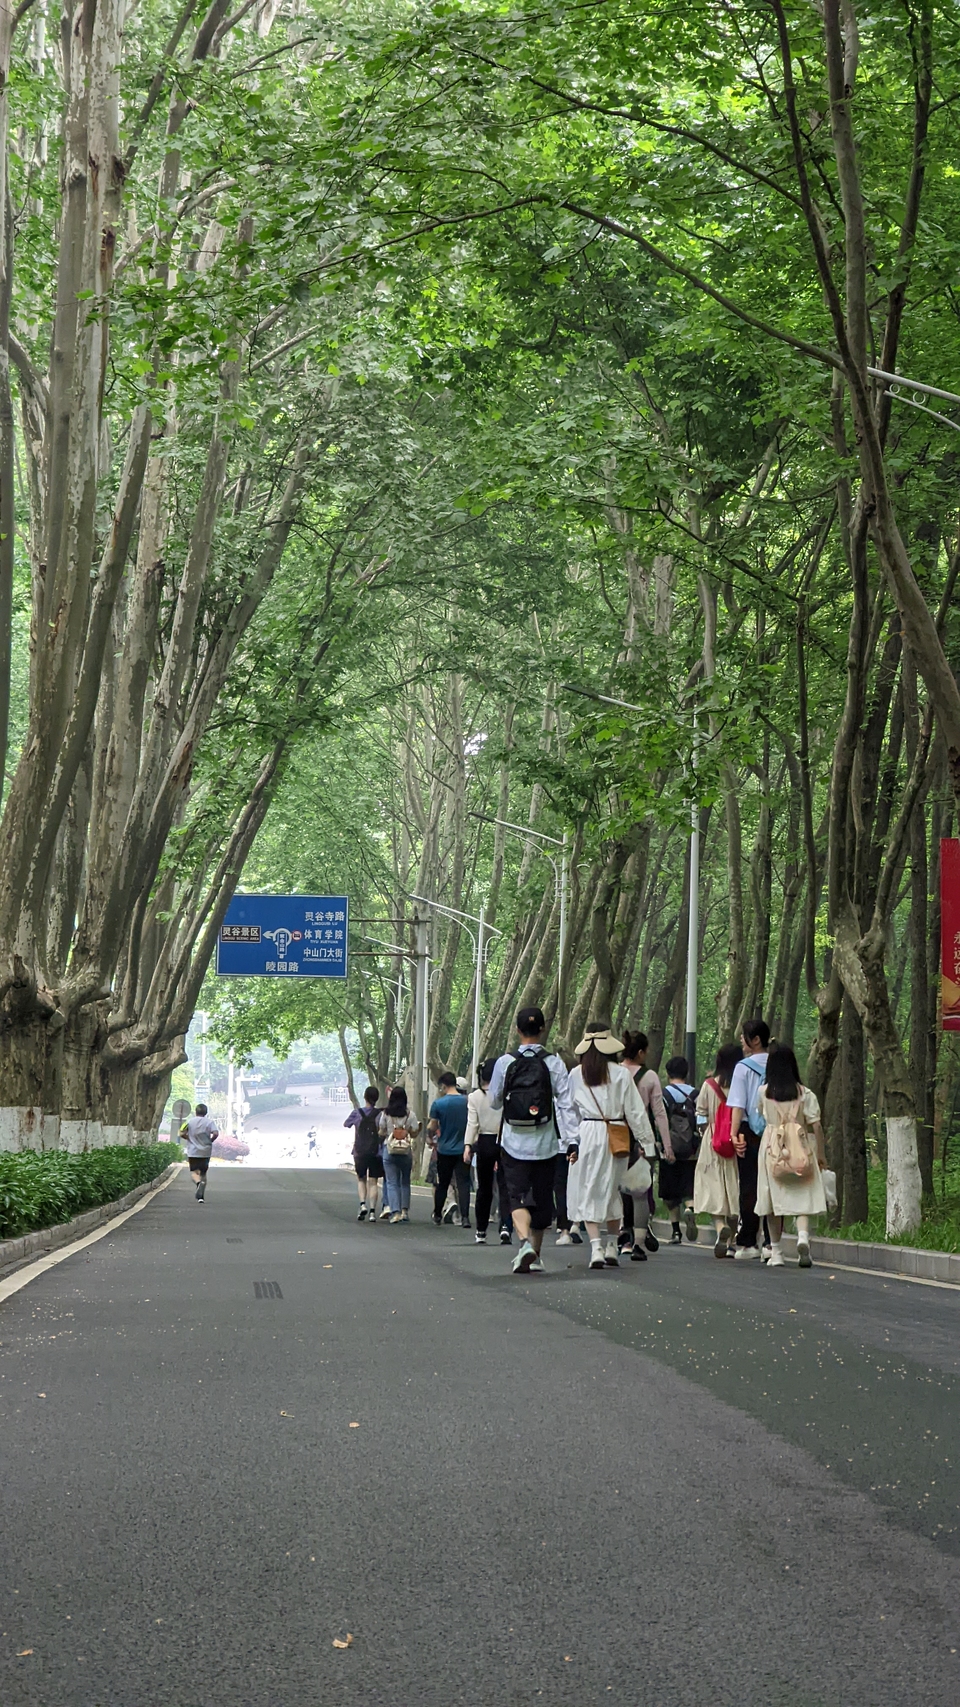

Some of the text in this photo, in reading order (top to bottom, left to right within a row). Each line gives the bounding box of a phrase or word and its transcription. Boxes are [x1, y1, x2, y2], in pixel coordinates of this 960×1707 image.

[305, 911, 344, 921] 灵谷寺路
[222, 927, 259, 936] 灵谷景区
[304, 929, 343, 940] 体育学院
[304, 948, 343, 957] 中山门大街
[265, 961, 299, 972] 陵园路
